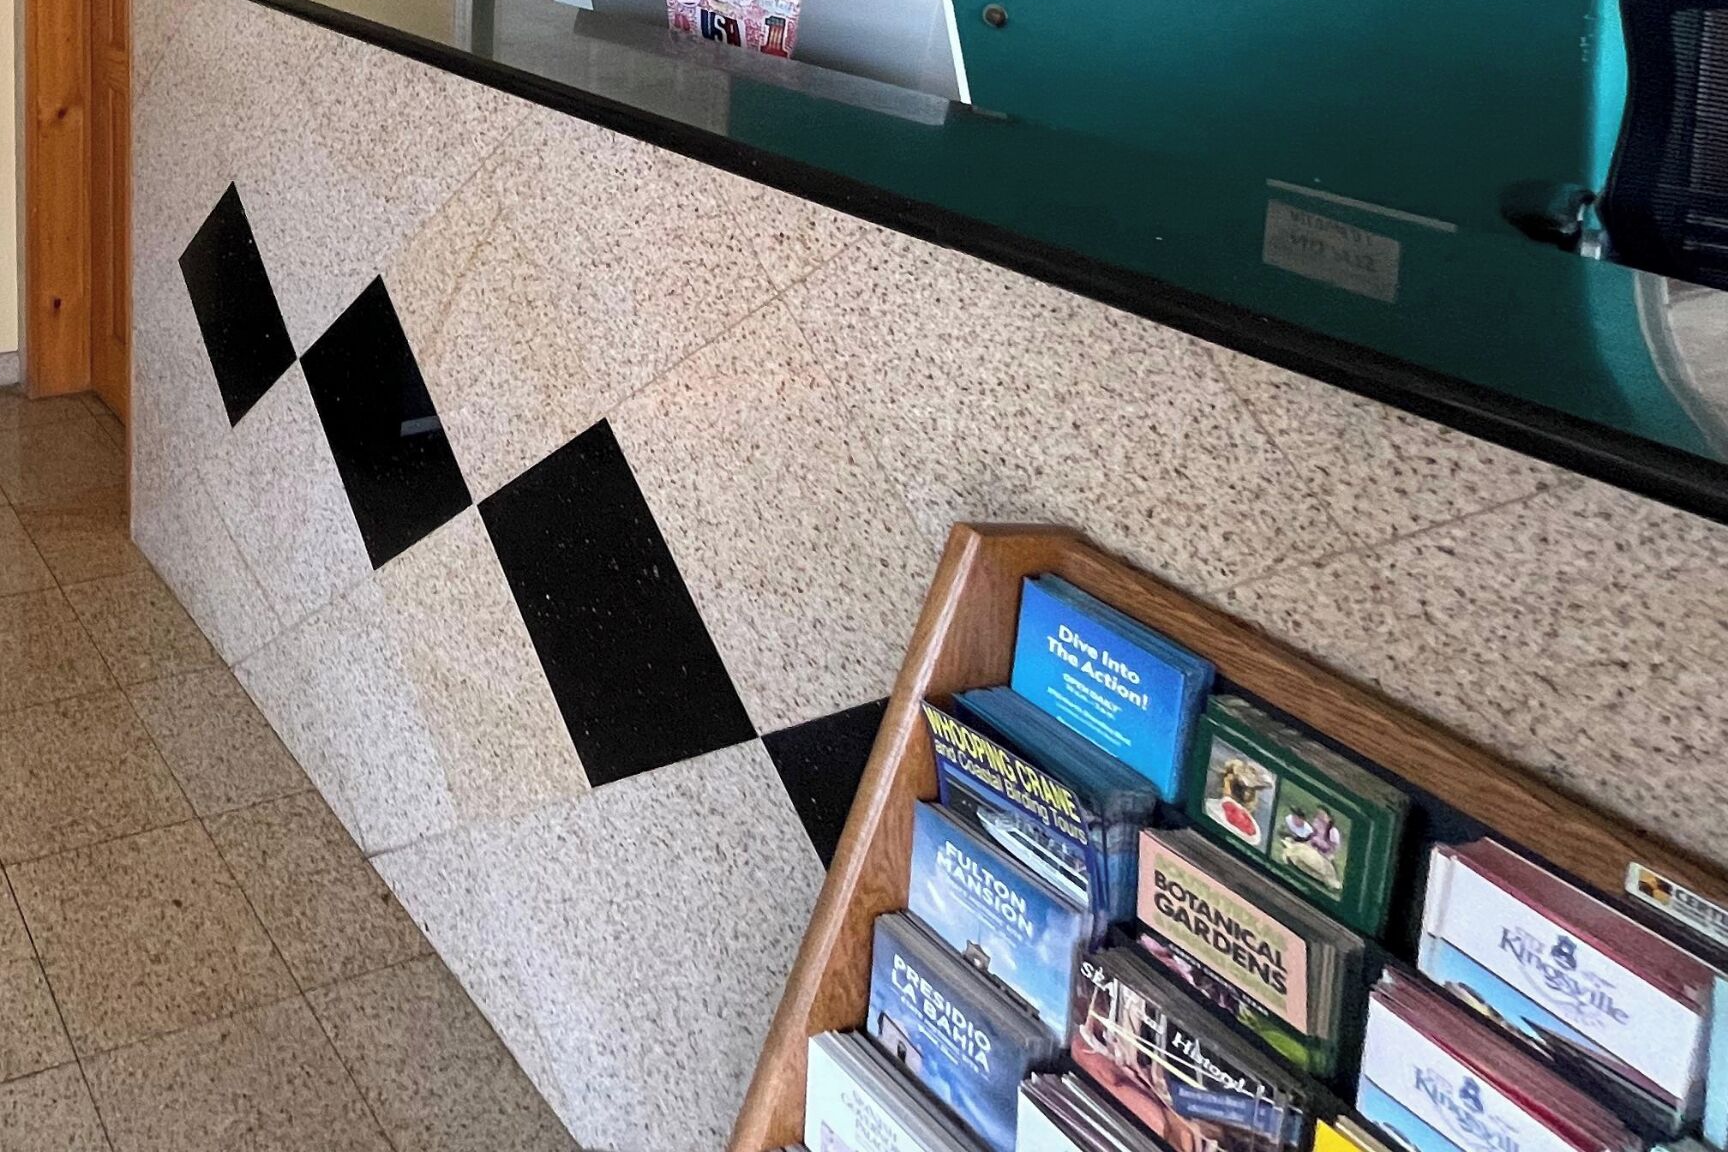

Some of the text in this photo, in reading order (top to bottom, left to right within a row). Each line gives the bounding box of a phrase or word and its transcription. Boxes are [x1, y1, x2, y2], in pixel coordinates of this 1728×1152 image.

[1047, 635, 1149, 712] The Action!
[1058, 624, 1141, 685] Dive Into
[922, 704, 1017, 784] WHOOPING
[1014, 759, 1082, 824] CRANE
[936, 849, 1034, 939] MANSION
[945, 840, 1027, 914] FULTON
[1154, 869, 1288, 975] BOTANICAL
[1154, 892, 1288, 995] GARDENS
[892, 968, 918, 1005] LA
[924, 998, 991, 1074] BAHIA
[894, 953, 992, 1053] PRESIDIO
